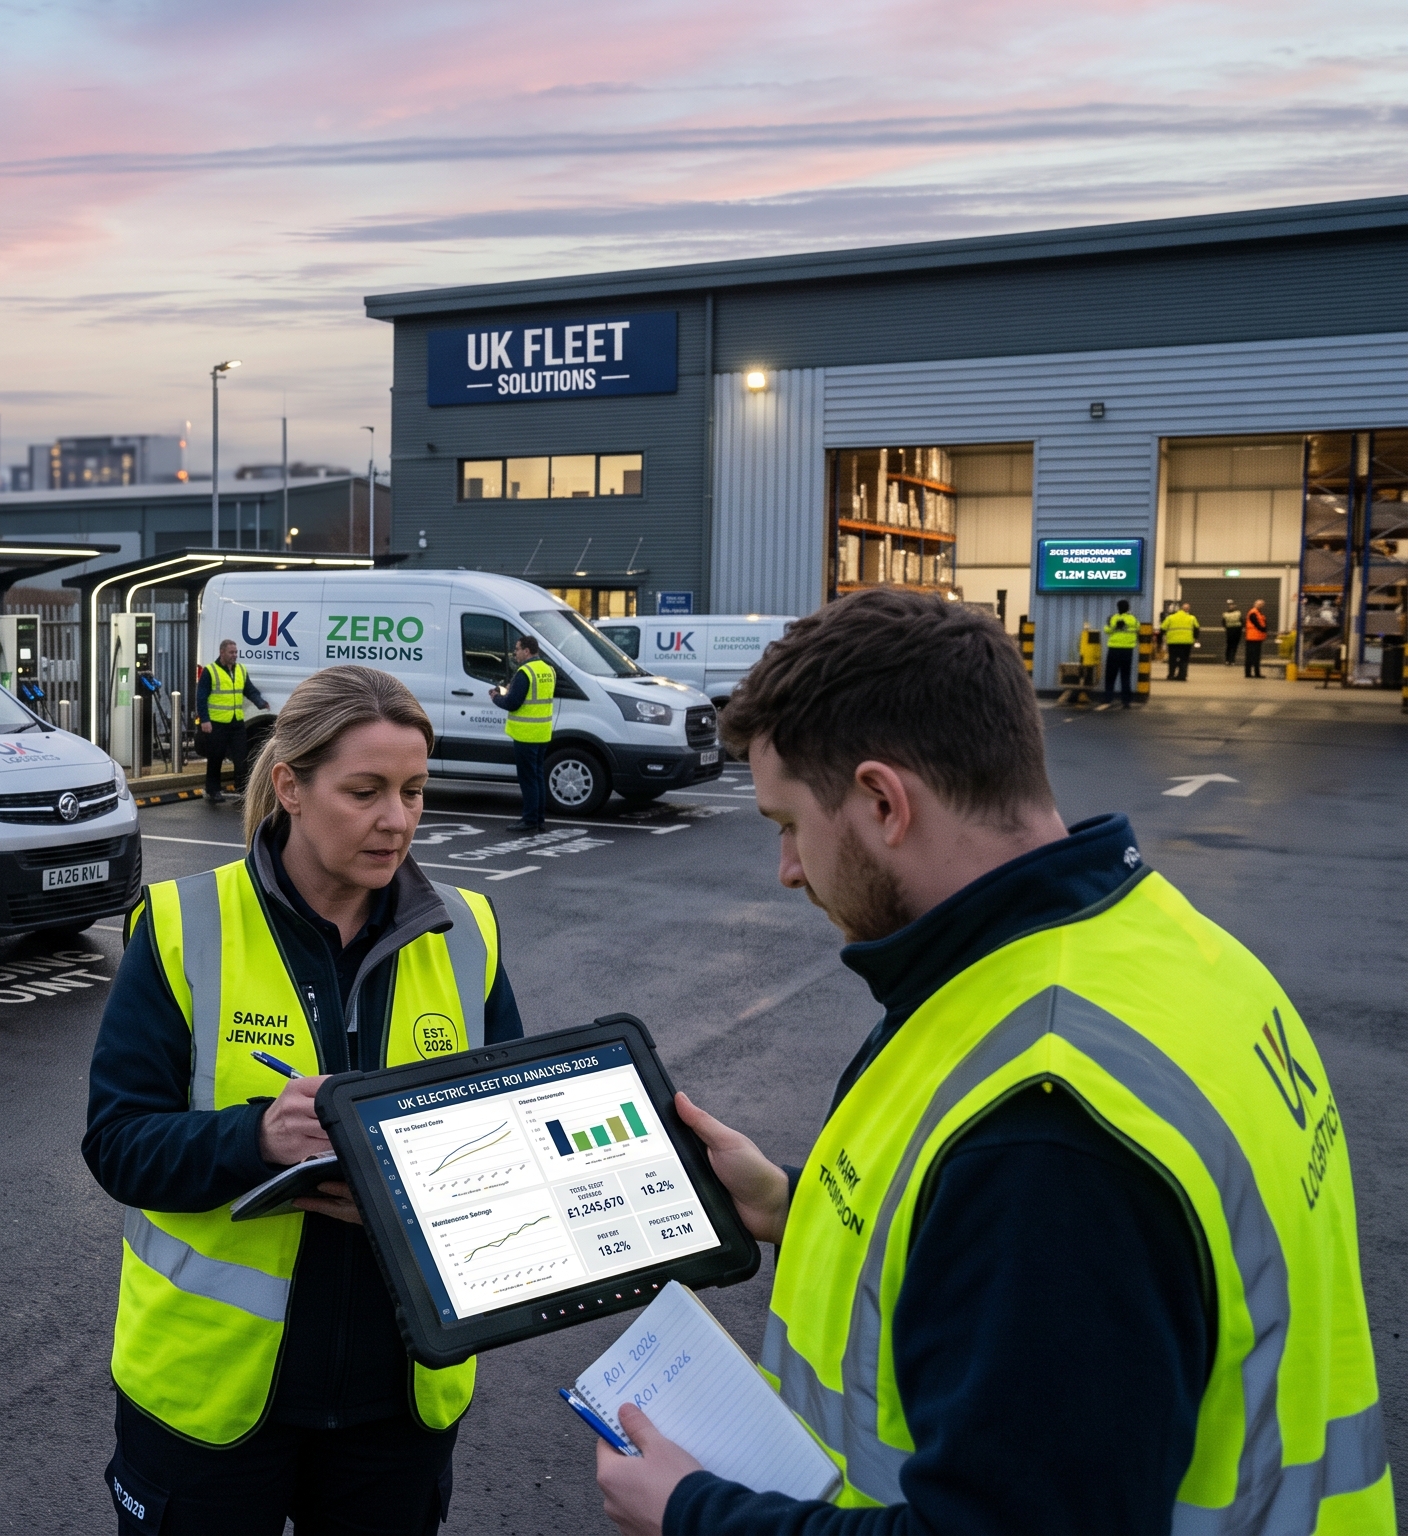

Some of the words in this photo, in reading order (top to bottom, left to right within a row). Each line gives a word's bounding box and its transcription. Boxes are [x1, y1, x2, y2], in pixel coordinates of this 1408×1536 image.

[467, 331, 513, 371] UK
[524, 321, 630, 367] FLEET
[497, 368, 596, 395] SOLUTIONS
[1087, 570, 1127, 580] SAVED
[242, 611, 298, 647] UK
[326, 615, 424, 643] ZERO
[656, 631, 695, 652] UK
[239, 650, 300, 661] LOGISTICS
[326, 645, 423, 661] EMISSIONS
[49, 868, 79, 886] EA26
[82, 865, 103, 881] RVL
[232, 1011, 289, 1028] SARAH
[225, 1029, 295, 1047] JENKINS
[423, 1027, 448, 1040] EST.
[423, 1039, 453, 1053] 2026
[1253, 1006, 1318, 1131] UK
[397, 1098, 416, 1110] UK
[416, 1086, 469, 1107] ELECTRIC
[469, 1078, 501, 1094] FLEET
[503, 1073, 523, 1086] ROI
[524, 1062, 572, 1082] ANALYSIS
[570, 1055, 599, 1071] 2026
[640, 1180, 675, 1195] 18.2%
[567, 1195, 624, 1219] £1,245,670
[661, 1222, 694, 1240] £2.1M
[603, 1362, 626, 1388] ROI
[629, 1331, 658, 1362] 2026
[634, 1383, 658, 1410] ROI
[663, 1350, 692, 1384] 2026
[122, 1491, 145, 1520] 2028
